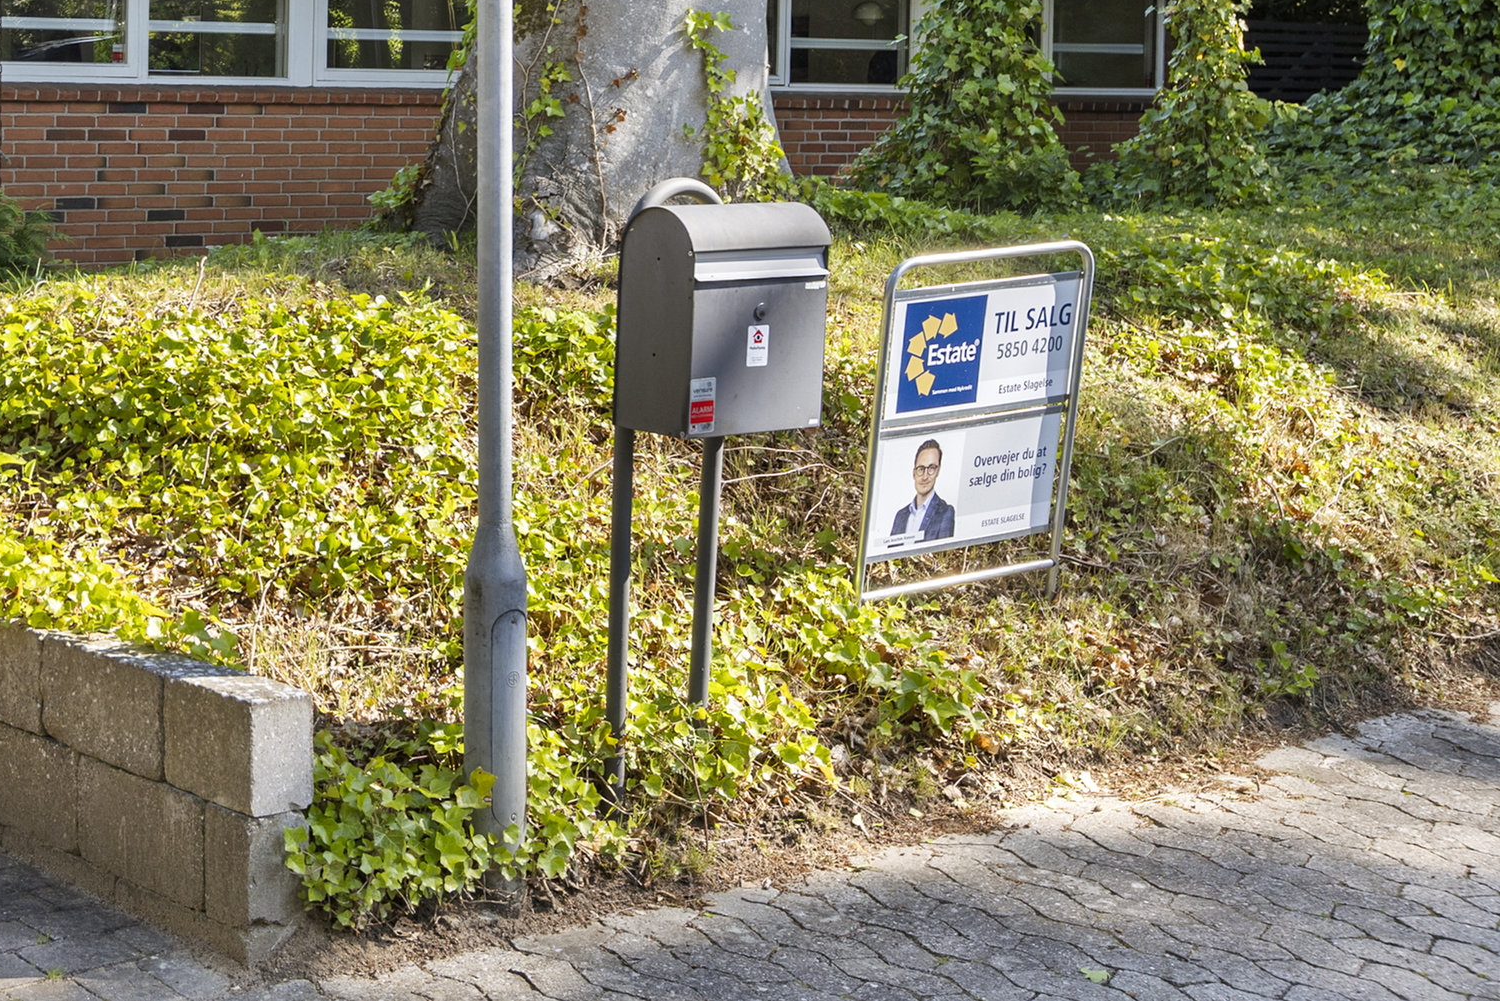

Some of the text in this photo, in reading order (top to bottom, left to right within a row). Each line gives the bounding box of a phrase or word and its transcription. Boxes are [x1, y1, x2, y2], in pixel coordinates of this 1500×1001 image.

[995, 303, 1072, 334] TIL SALG
[927, 341, 977, 366] Estate
[996, 335, 1063, 359] 5850 4200
[998, 378, 1053, 394] Estate Slagelse
[692, 405, 713, 414] ALARM
[973, 446, 1047, 468] Overvejer du at
[969, 463, 1047, 487] sælge din bolig?
[981, 512, 1025, 527] ESTATE SLAGELSE
